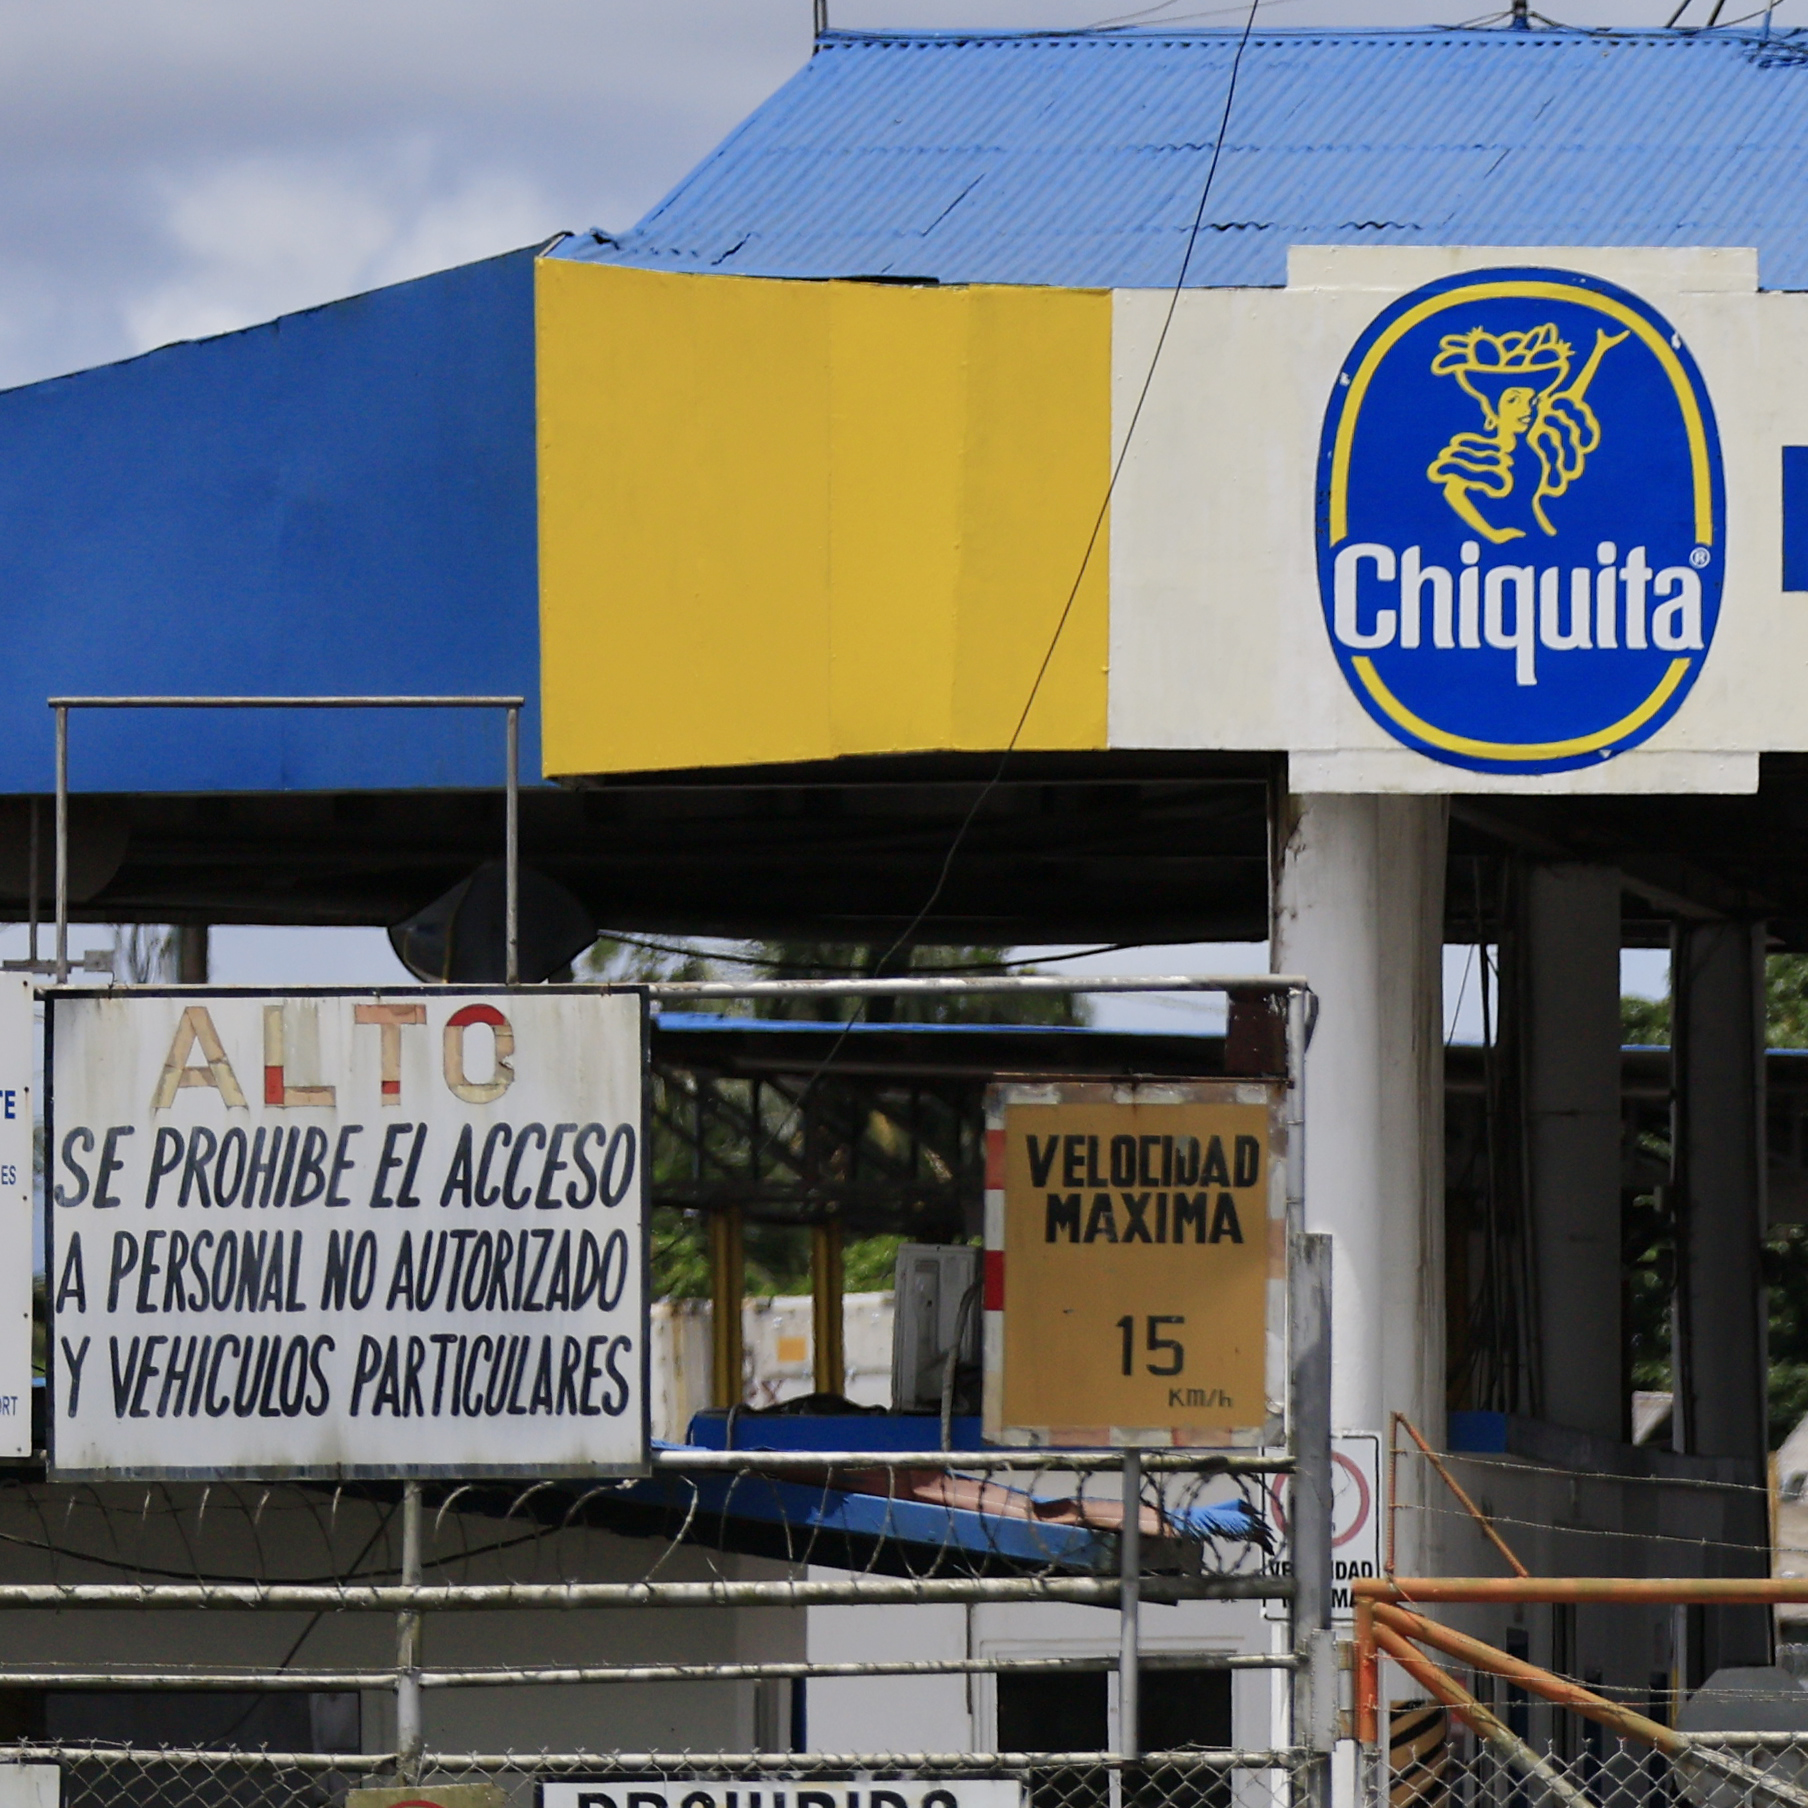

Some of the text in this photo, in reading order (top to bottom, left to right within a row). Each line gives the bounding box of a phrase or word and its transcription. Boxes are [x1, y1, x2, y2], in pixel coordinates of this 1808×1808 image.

[151, 1003, 516, 1110] ALTO
[54, 1122, 637, 1209] SE PROHIBE EL ACCESO
[1025, 1134, 1261, 1188] VELOCIDAD
[1044, 1192, 1244, 1244] MAXIMA
[56, 1229, 629, 1313] A PERSONAL NO AUTORIZADO
[61, 1334, 632, 1418] Y VEHICULOS PARTICULARES
[1116, 1315, 1186, 1377] 15
